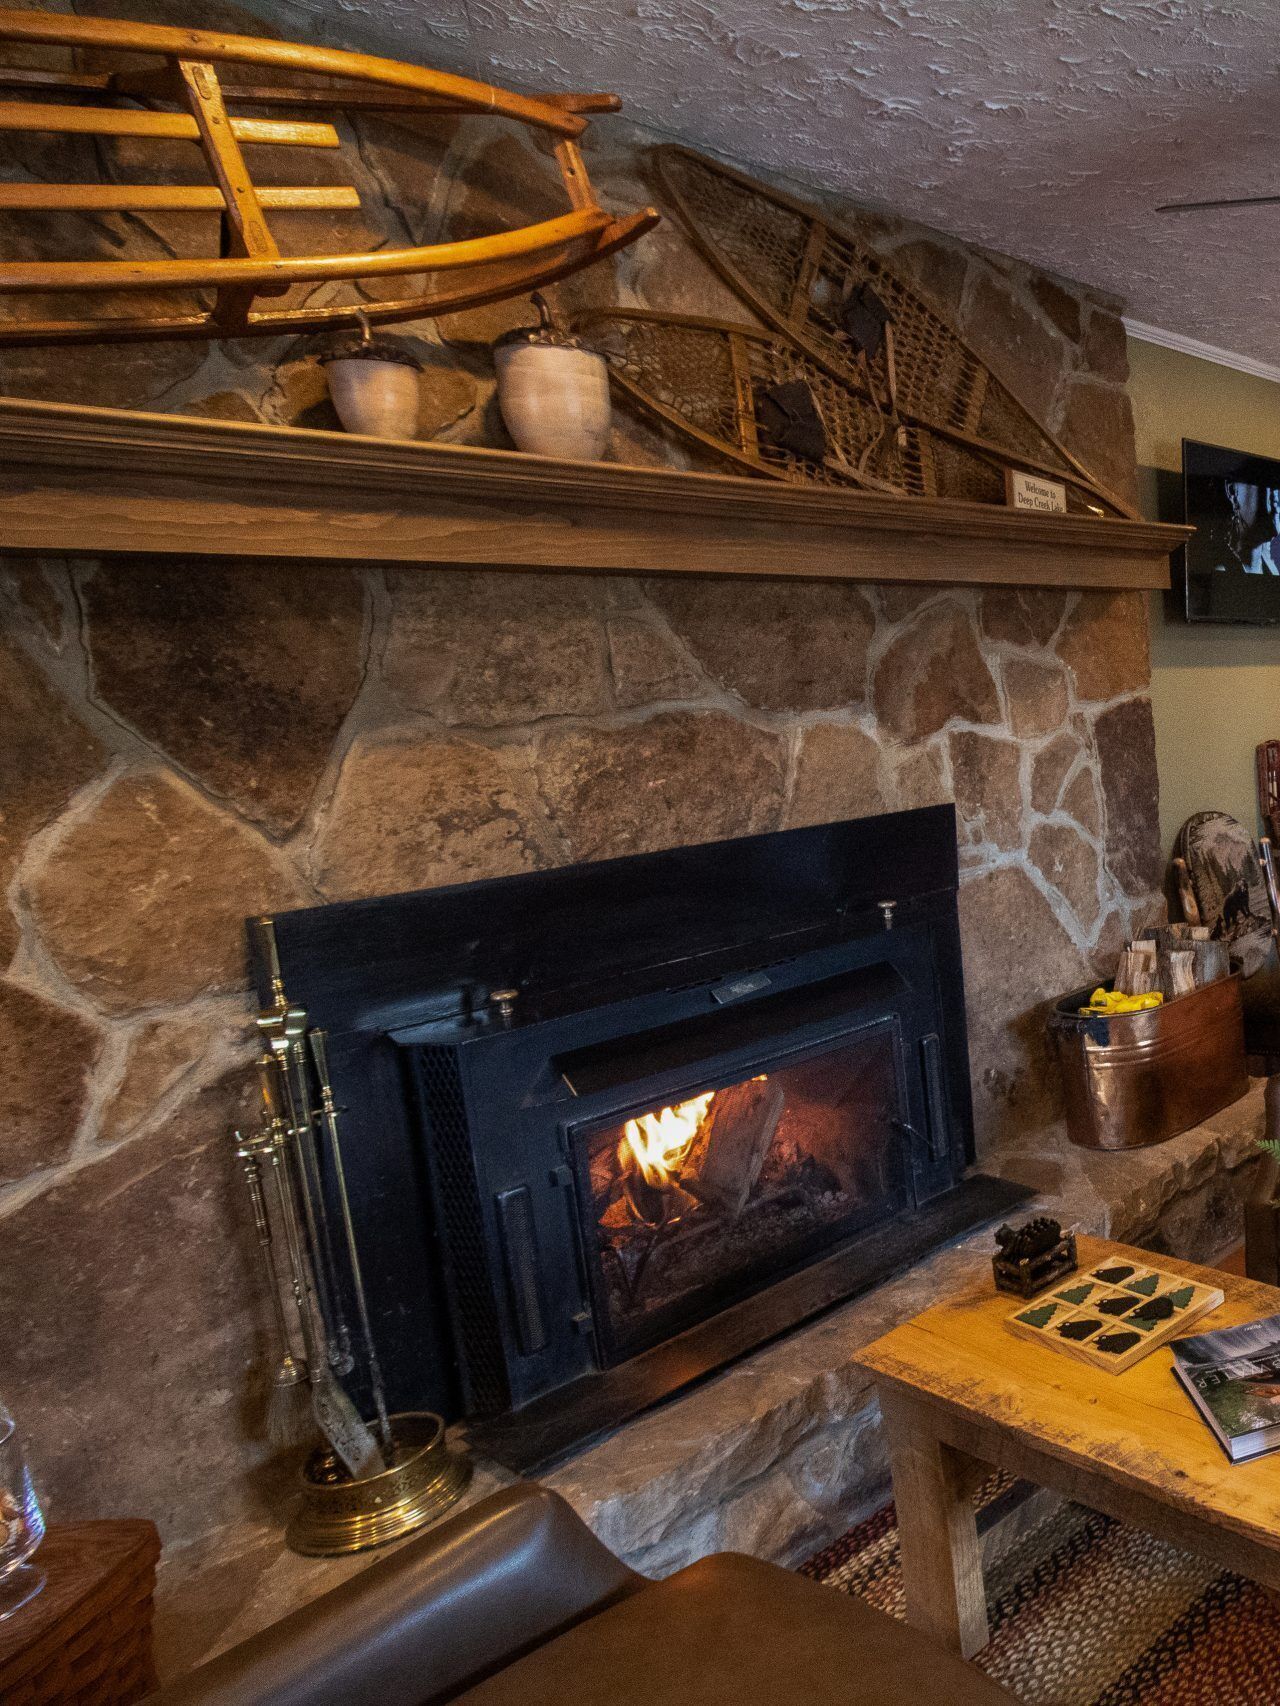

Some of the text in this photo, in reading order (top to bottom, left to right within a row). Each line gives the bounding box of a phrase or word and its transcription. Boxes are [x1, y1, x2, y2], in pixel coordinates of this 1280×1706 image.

[1025, 480, 1056, 499] Welcome to
[1018, 492, 1033, 508] Deep
[1035, 496, 1050, 511] Creek
